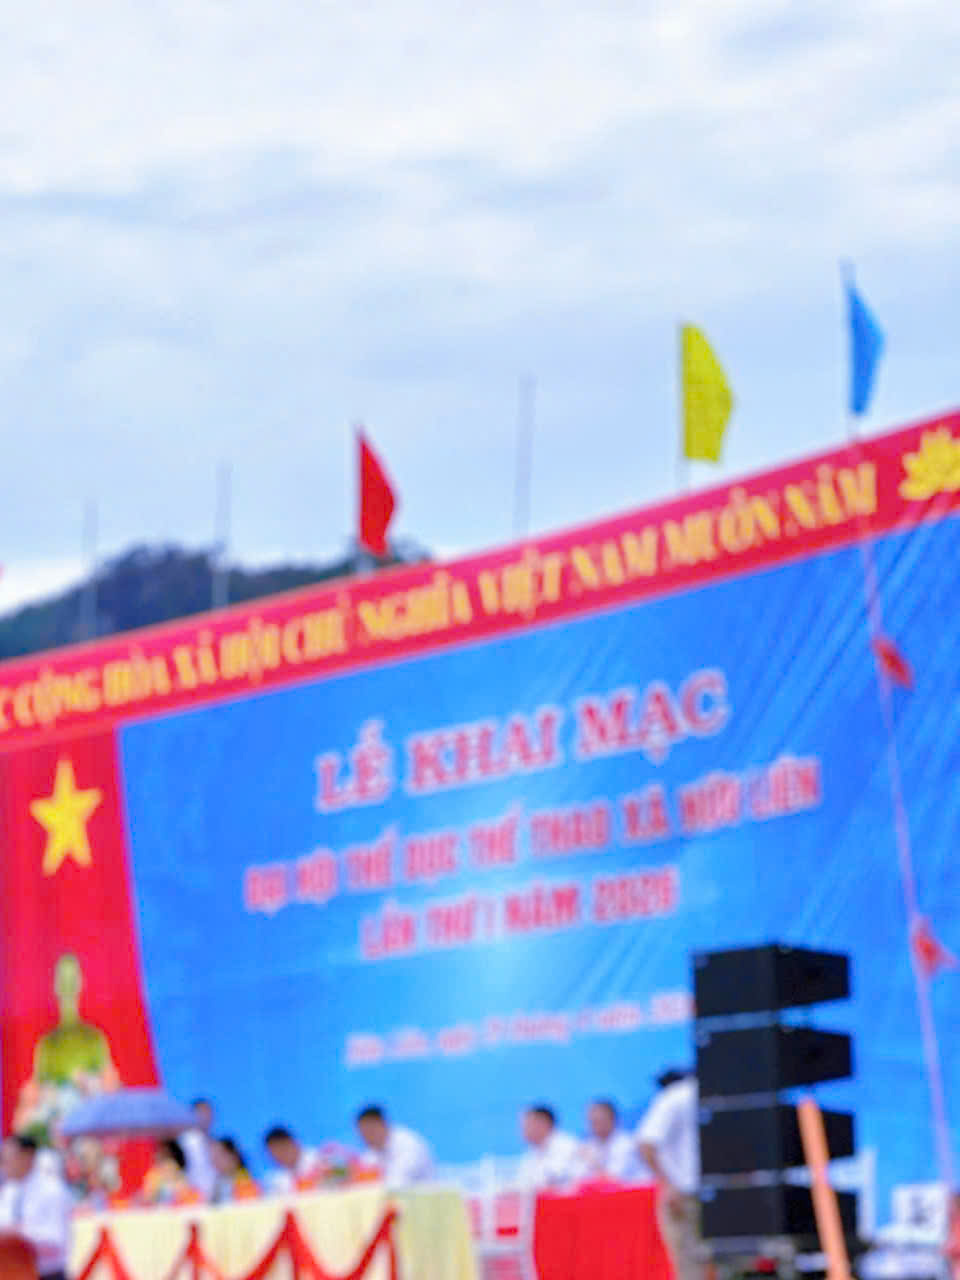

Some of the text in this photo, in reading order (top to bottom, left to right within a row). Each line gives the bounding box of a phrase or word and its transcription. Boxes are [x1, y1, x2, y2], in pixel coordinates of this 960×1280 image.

[478, 544, 563, 620] VIỆT
[569, 525, 659, 595] NAM
[782, 462, 878, 535] NĂM
[405, 703, 565, 794] KHAI
[574, 667, 732, 766] MẠC
[530, 807, 611, 857] THAO
